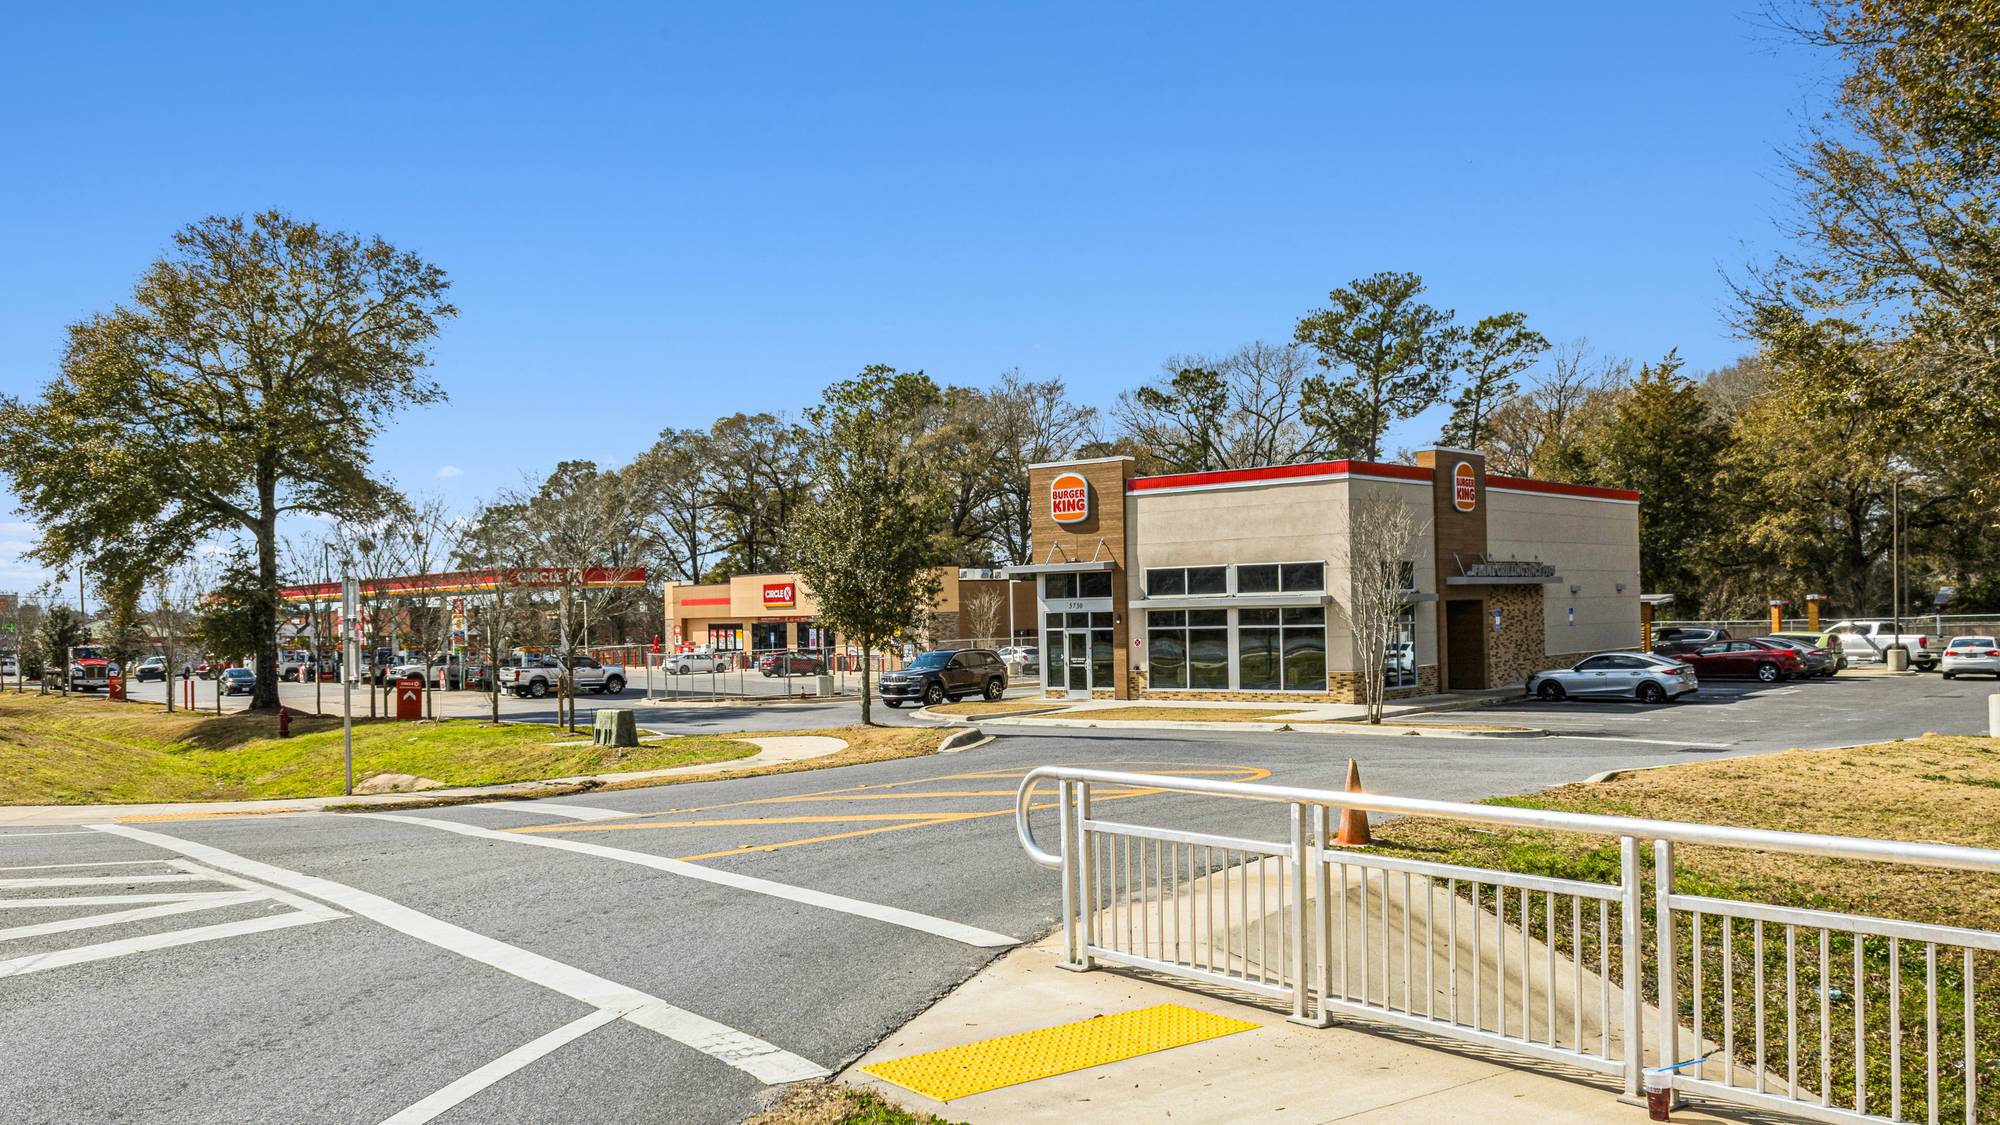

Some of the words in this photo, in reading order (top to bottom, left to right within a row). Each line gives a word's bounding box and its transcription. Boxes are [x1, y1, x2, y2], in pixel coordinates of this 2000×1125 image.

[1456, 477, 1474, 487] BURGER
[1052, 489, 1085, 500] BURGER
[1456, 486, 1475, 501] KING
[1053, 499, 1085, 513] KING
[765, 590, 784, 598] CIRCLE
